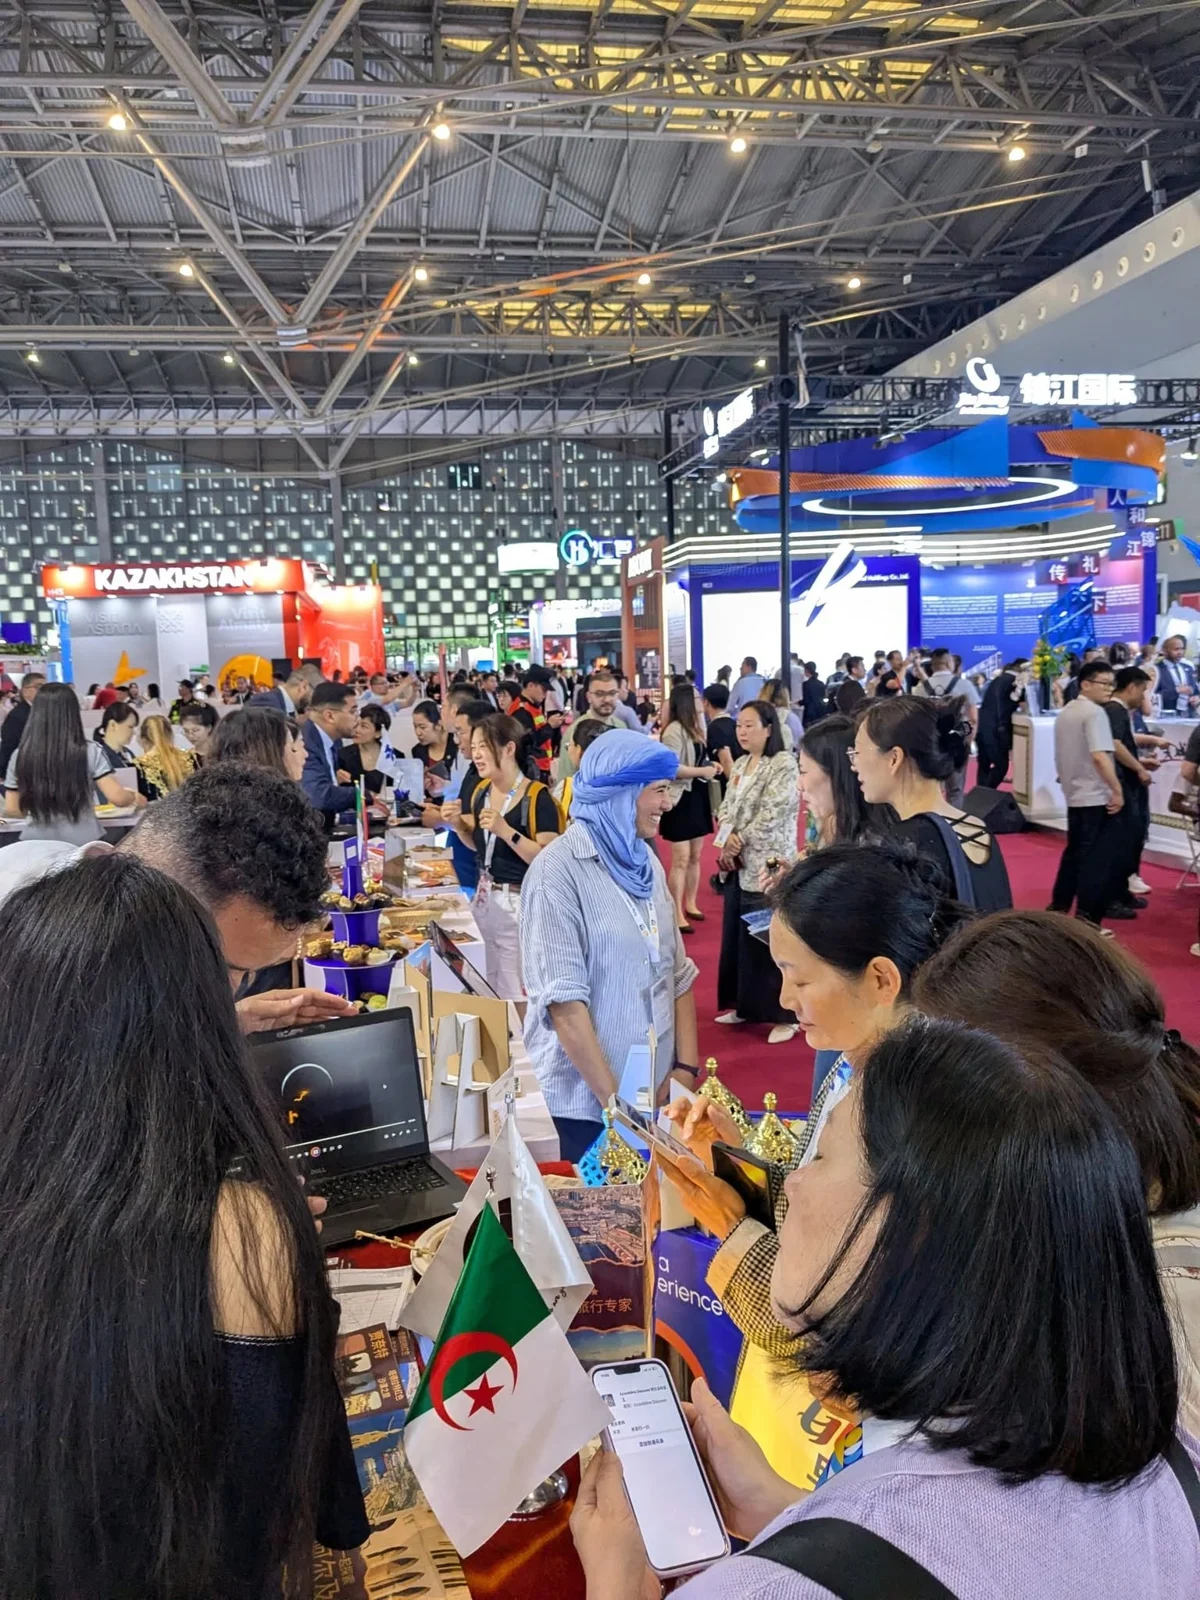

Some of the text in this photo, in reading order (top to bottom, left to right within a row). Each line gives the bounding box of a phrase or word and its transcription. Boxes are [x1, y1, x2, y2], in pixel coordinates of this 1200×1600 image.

[1020, 372, 1137, 406] 锦江国际
[1110, 489, 1125, 506] 人
[1129, 507, 1146, 524] 和
[1126, 540, 1141, 556] 江
[1049, 564, 1067, 581] 传
[1082, 555, 1099, 573] 礼
[94, 566, 254, 590] KAZAKHSTAN
[1091, 595, 1106, 612] 下
[579, 1297, 632, 1314] 旅行专家
